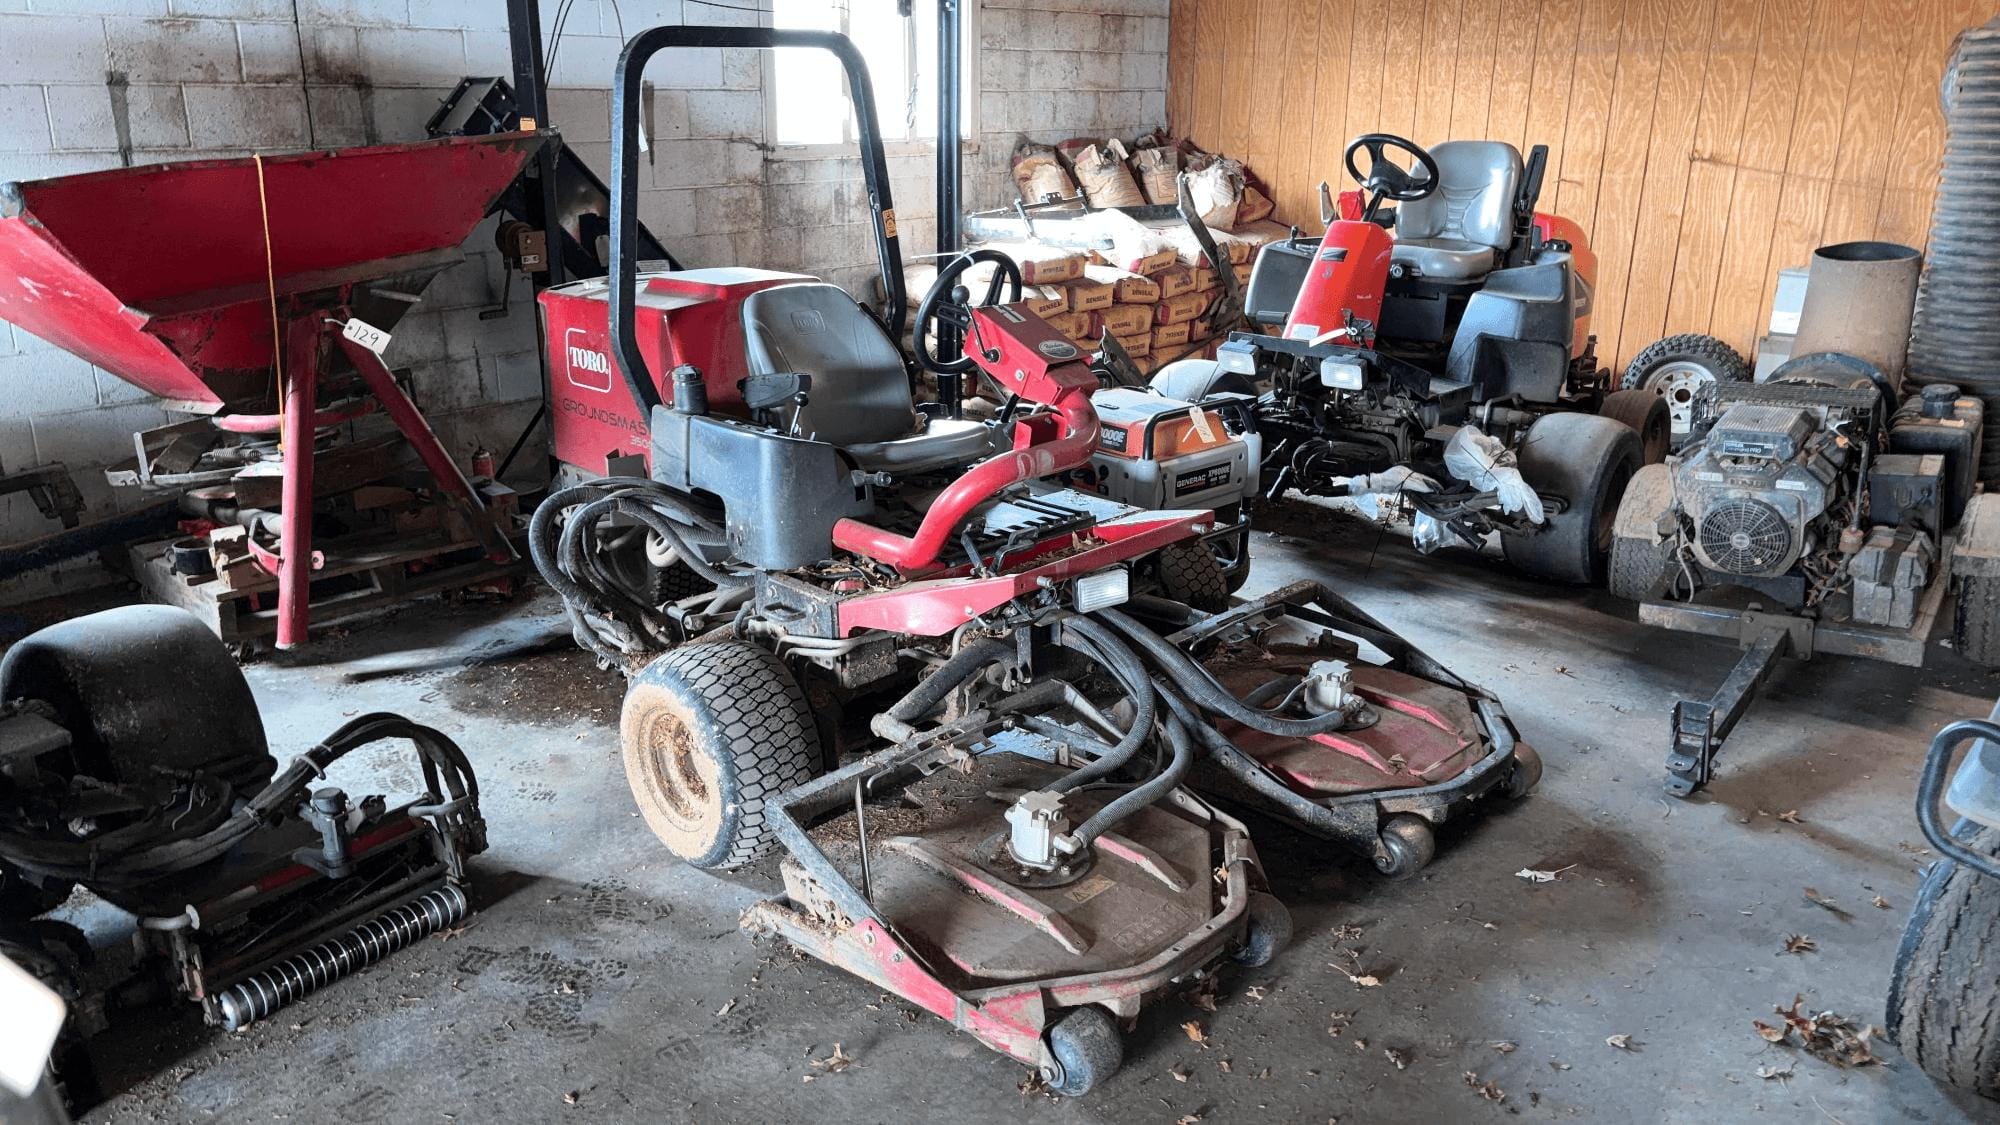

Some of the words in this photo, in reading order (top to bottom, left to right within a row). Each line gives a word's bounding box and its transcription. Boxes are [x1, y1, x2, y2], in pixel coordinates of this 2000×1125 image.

[353, 325, 379, 346] 129
[569, 346, 608, 374] TORO
[1176, 474, 1206, 488] GENERAC
